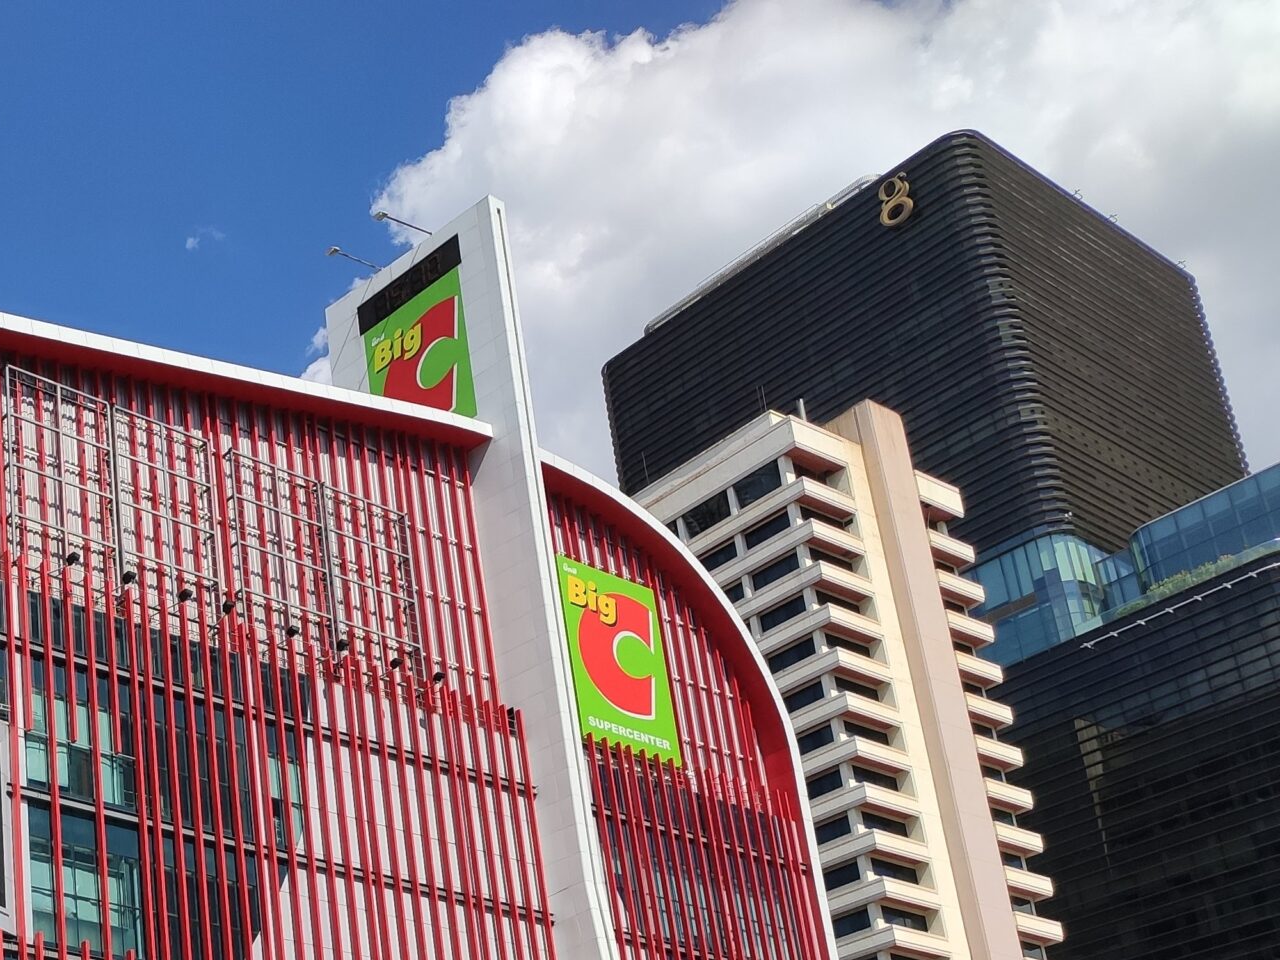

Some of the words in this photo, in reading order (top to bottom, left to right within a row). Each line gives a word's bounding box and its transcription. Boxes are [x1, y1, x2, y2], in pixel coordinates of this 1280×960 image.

[374, 322, 422, 375] Big
[383, 295, 458, 412] C
[567, 575, 617, 627] Big
[578, 591, 656, 721] C
[588, 715, 672, 751] SUPERCENTER
